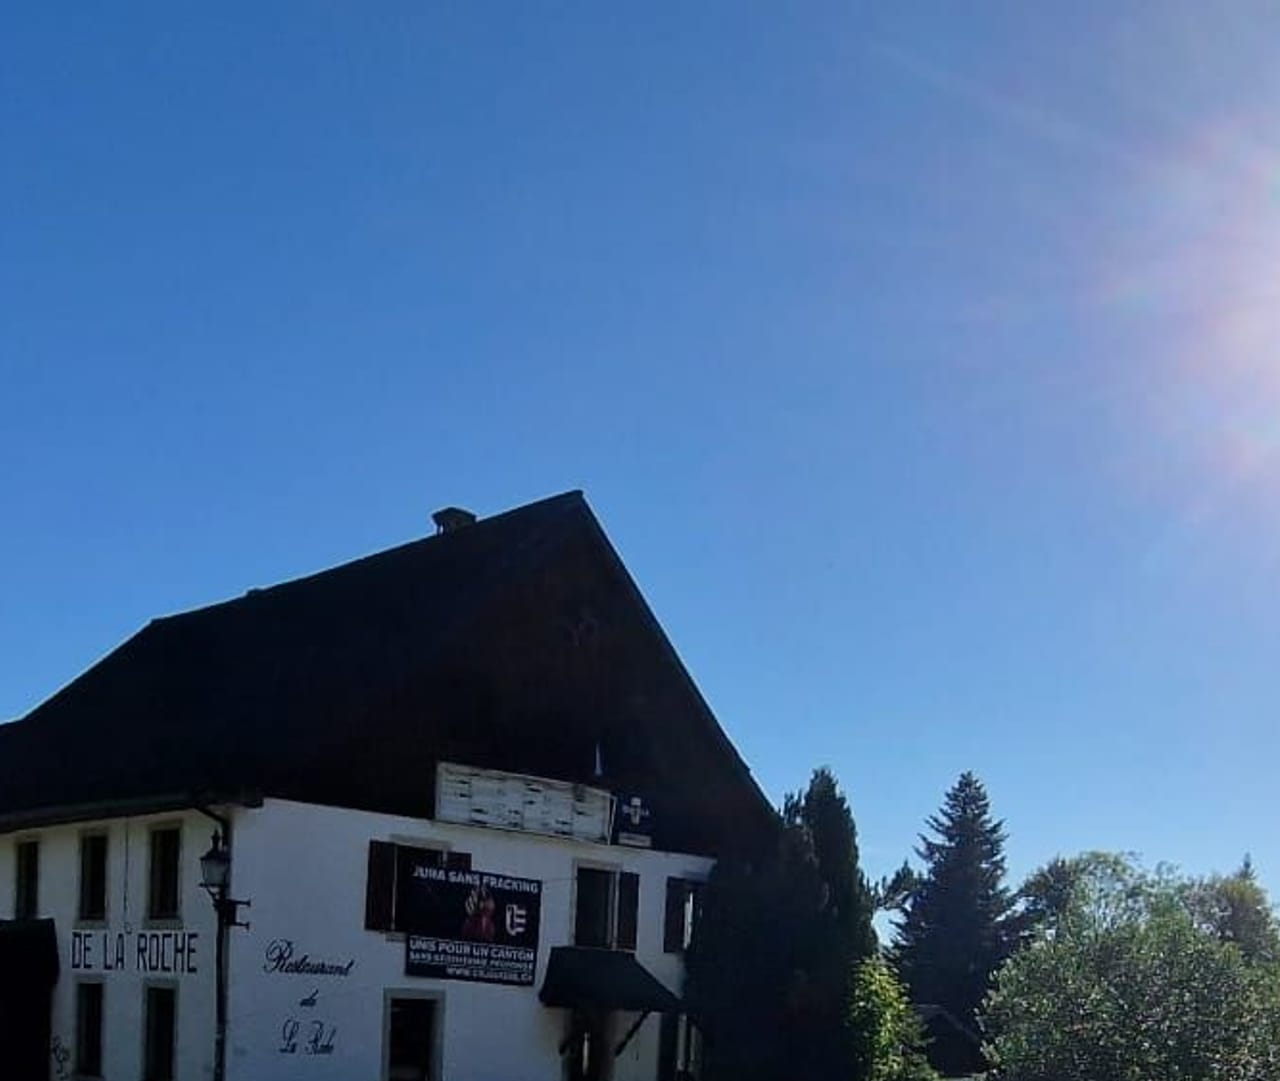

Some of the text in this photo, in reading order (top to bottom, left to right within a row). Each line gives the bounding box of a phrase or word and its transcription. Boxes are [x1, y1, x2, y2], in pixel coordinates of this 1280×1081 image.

[448, 870, 481, 887] SANS
[482, 875, 539, 894] FRACKING
[72, 931, 93, 969] DE
[104, 932, 125, 971] LA
[137, 933, 199, 974] ROCHE
[438, 941, 471, 956] POUR
[472, 944, 489, 958] UN
